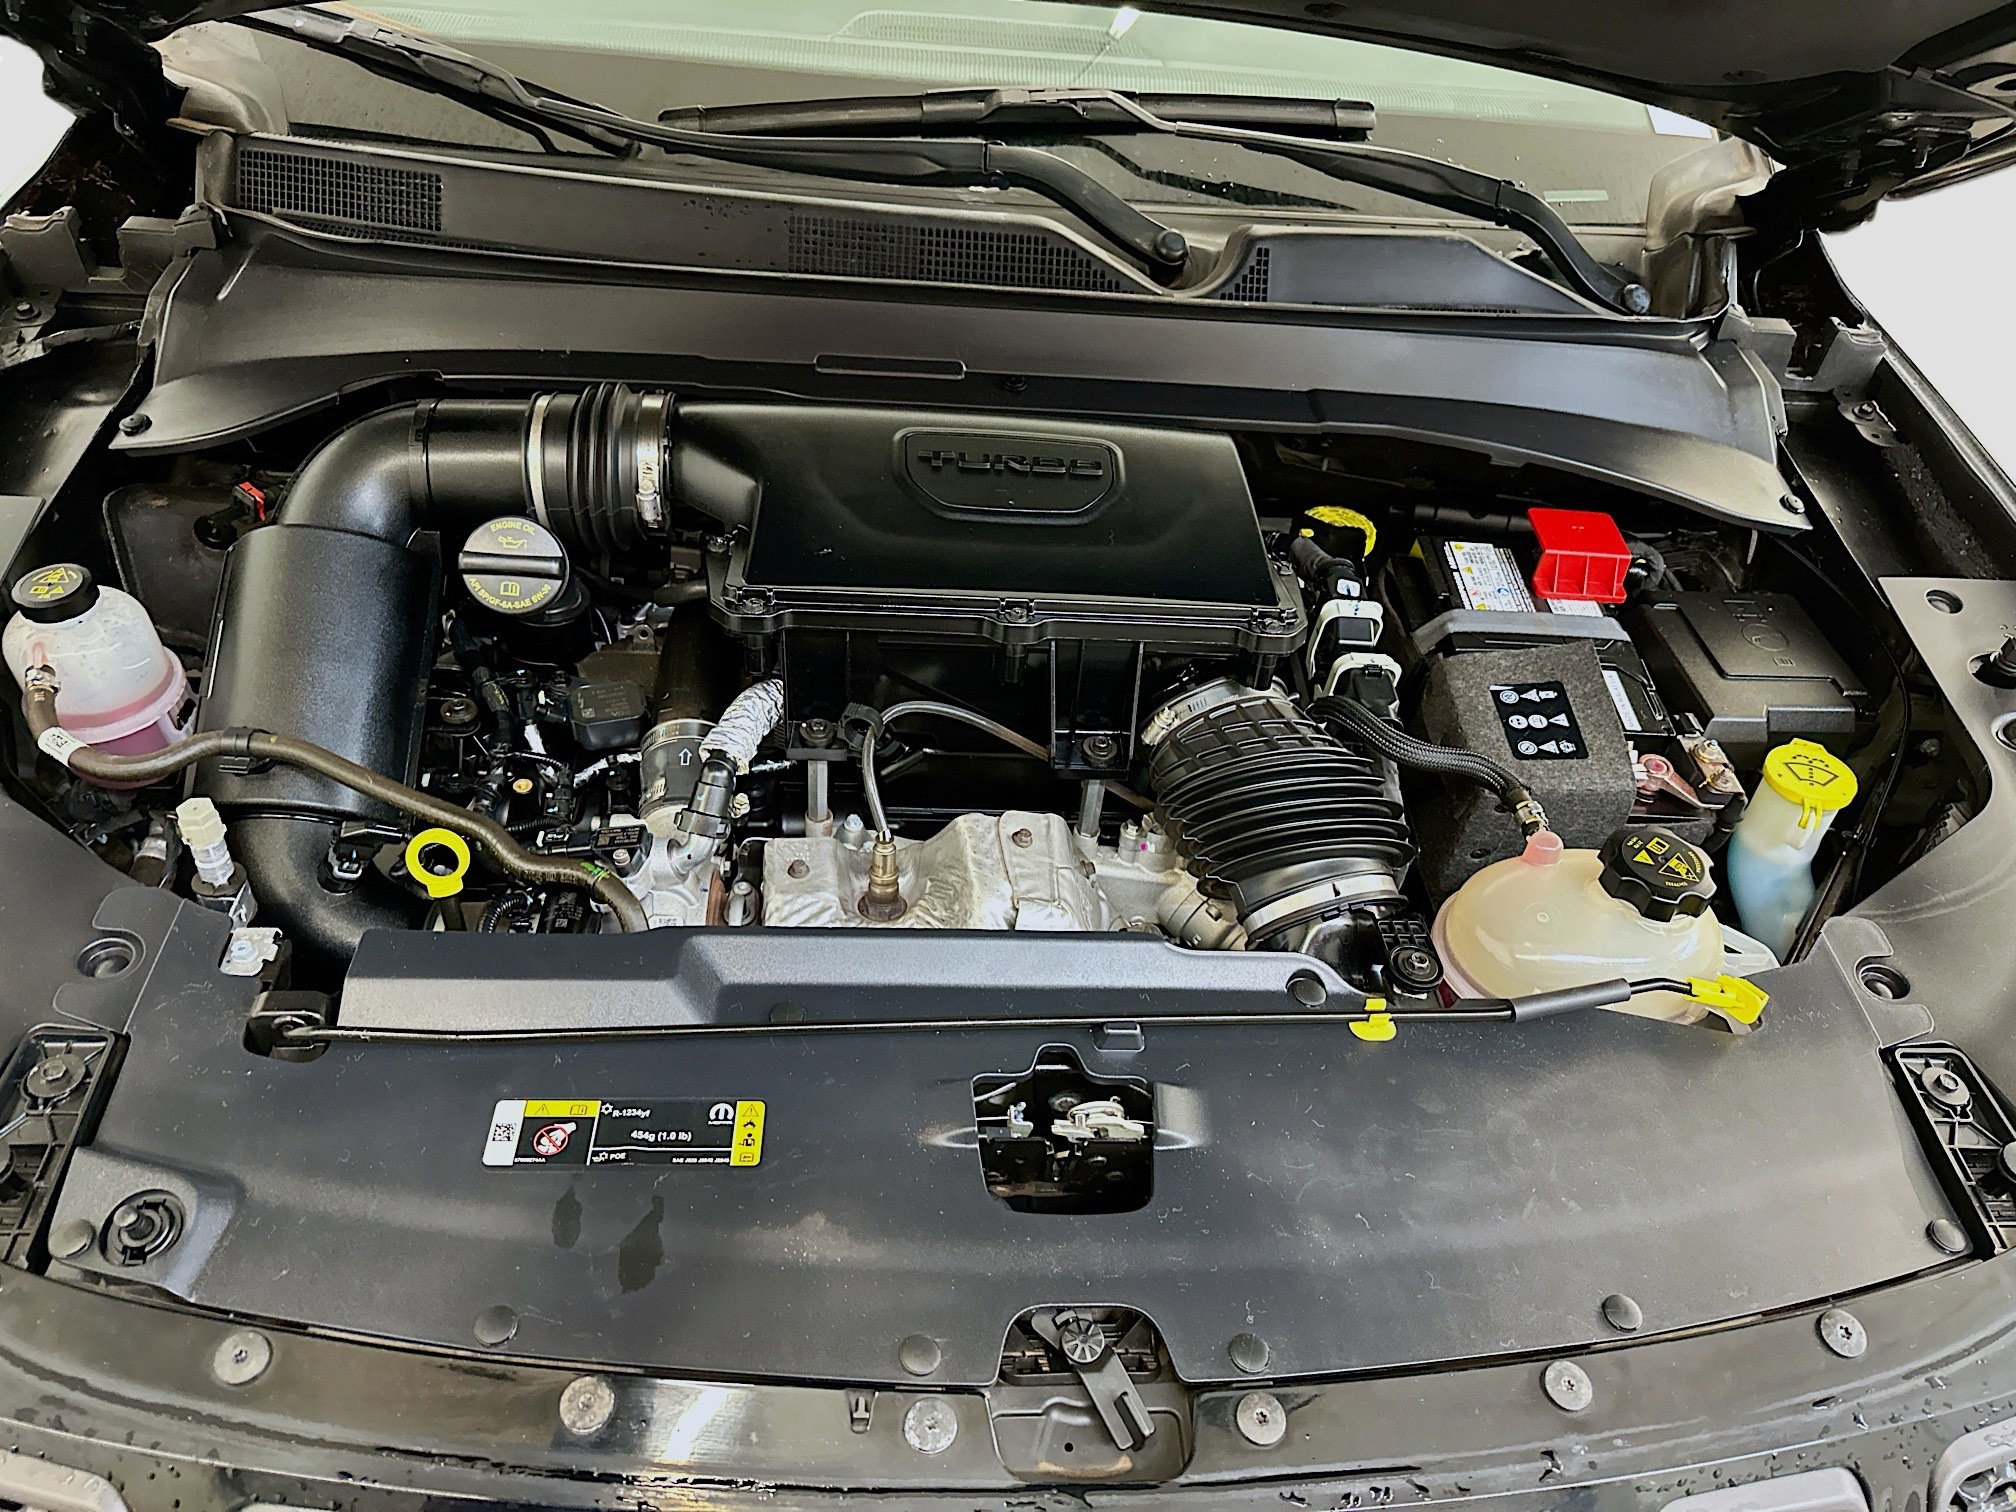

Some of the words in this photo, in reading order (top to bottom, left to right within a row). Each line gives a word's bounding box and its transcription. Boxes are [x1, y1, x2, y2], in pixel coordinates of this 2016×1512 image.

[917, 449, 1104, 477] TURBO
[491, 521, 522, 532] ENGINE
[523, 523, 536, 535] OIL
[612, 1109, 650, 1118] R-1234yf
[631, 1130, 656, 1142] 454g
[657, 1131, 677, 1142] (1.0
[678, 1131, 692, 1142] lb)
[609, 1152, 627, 1160] POE
